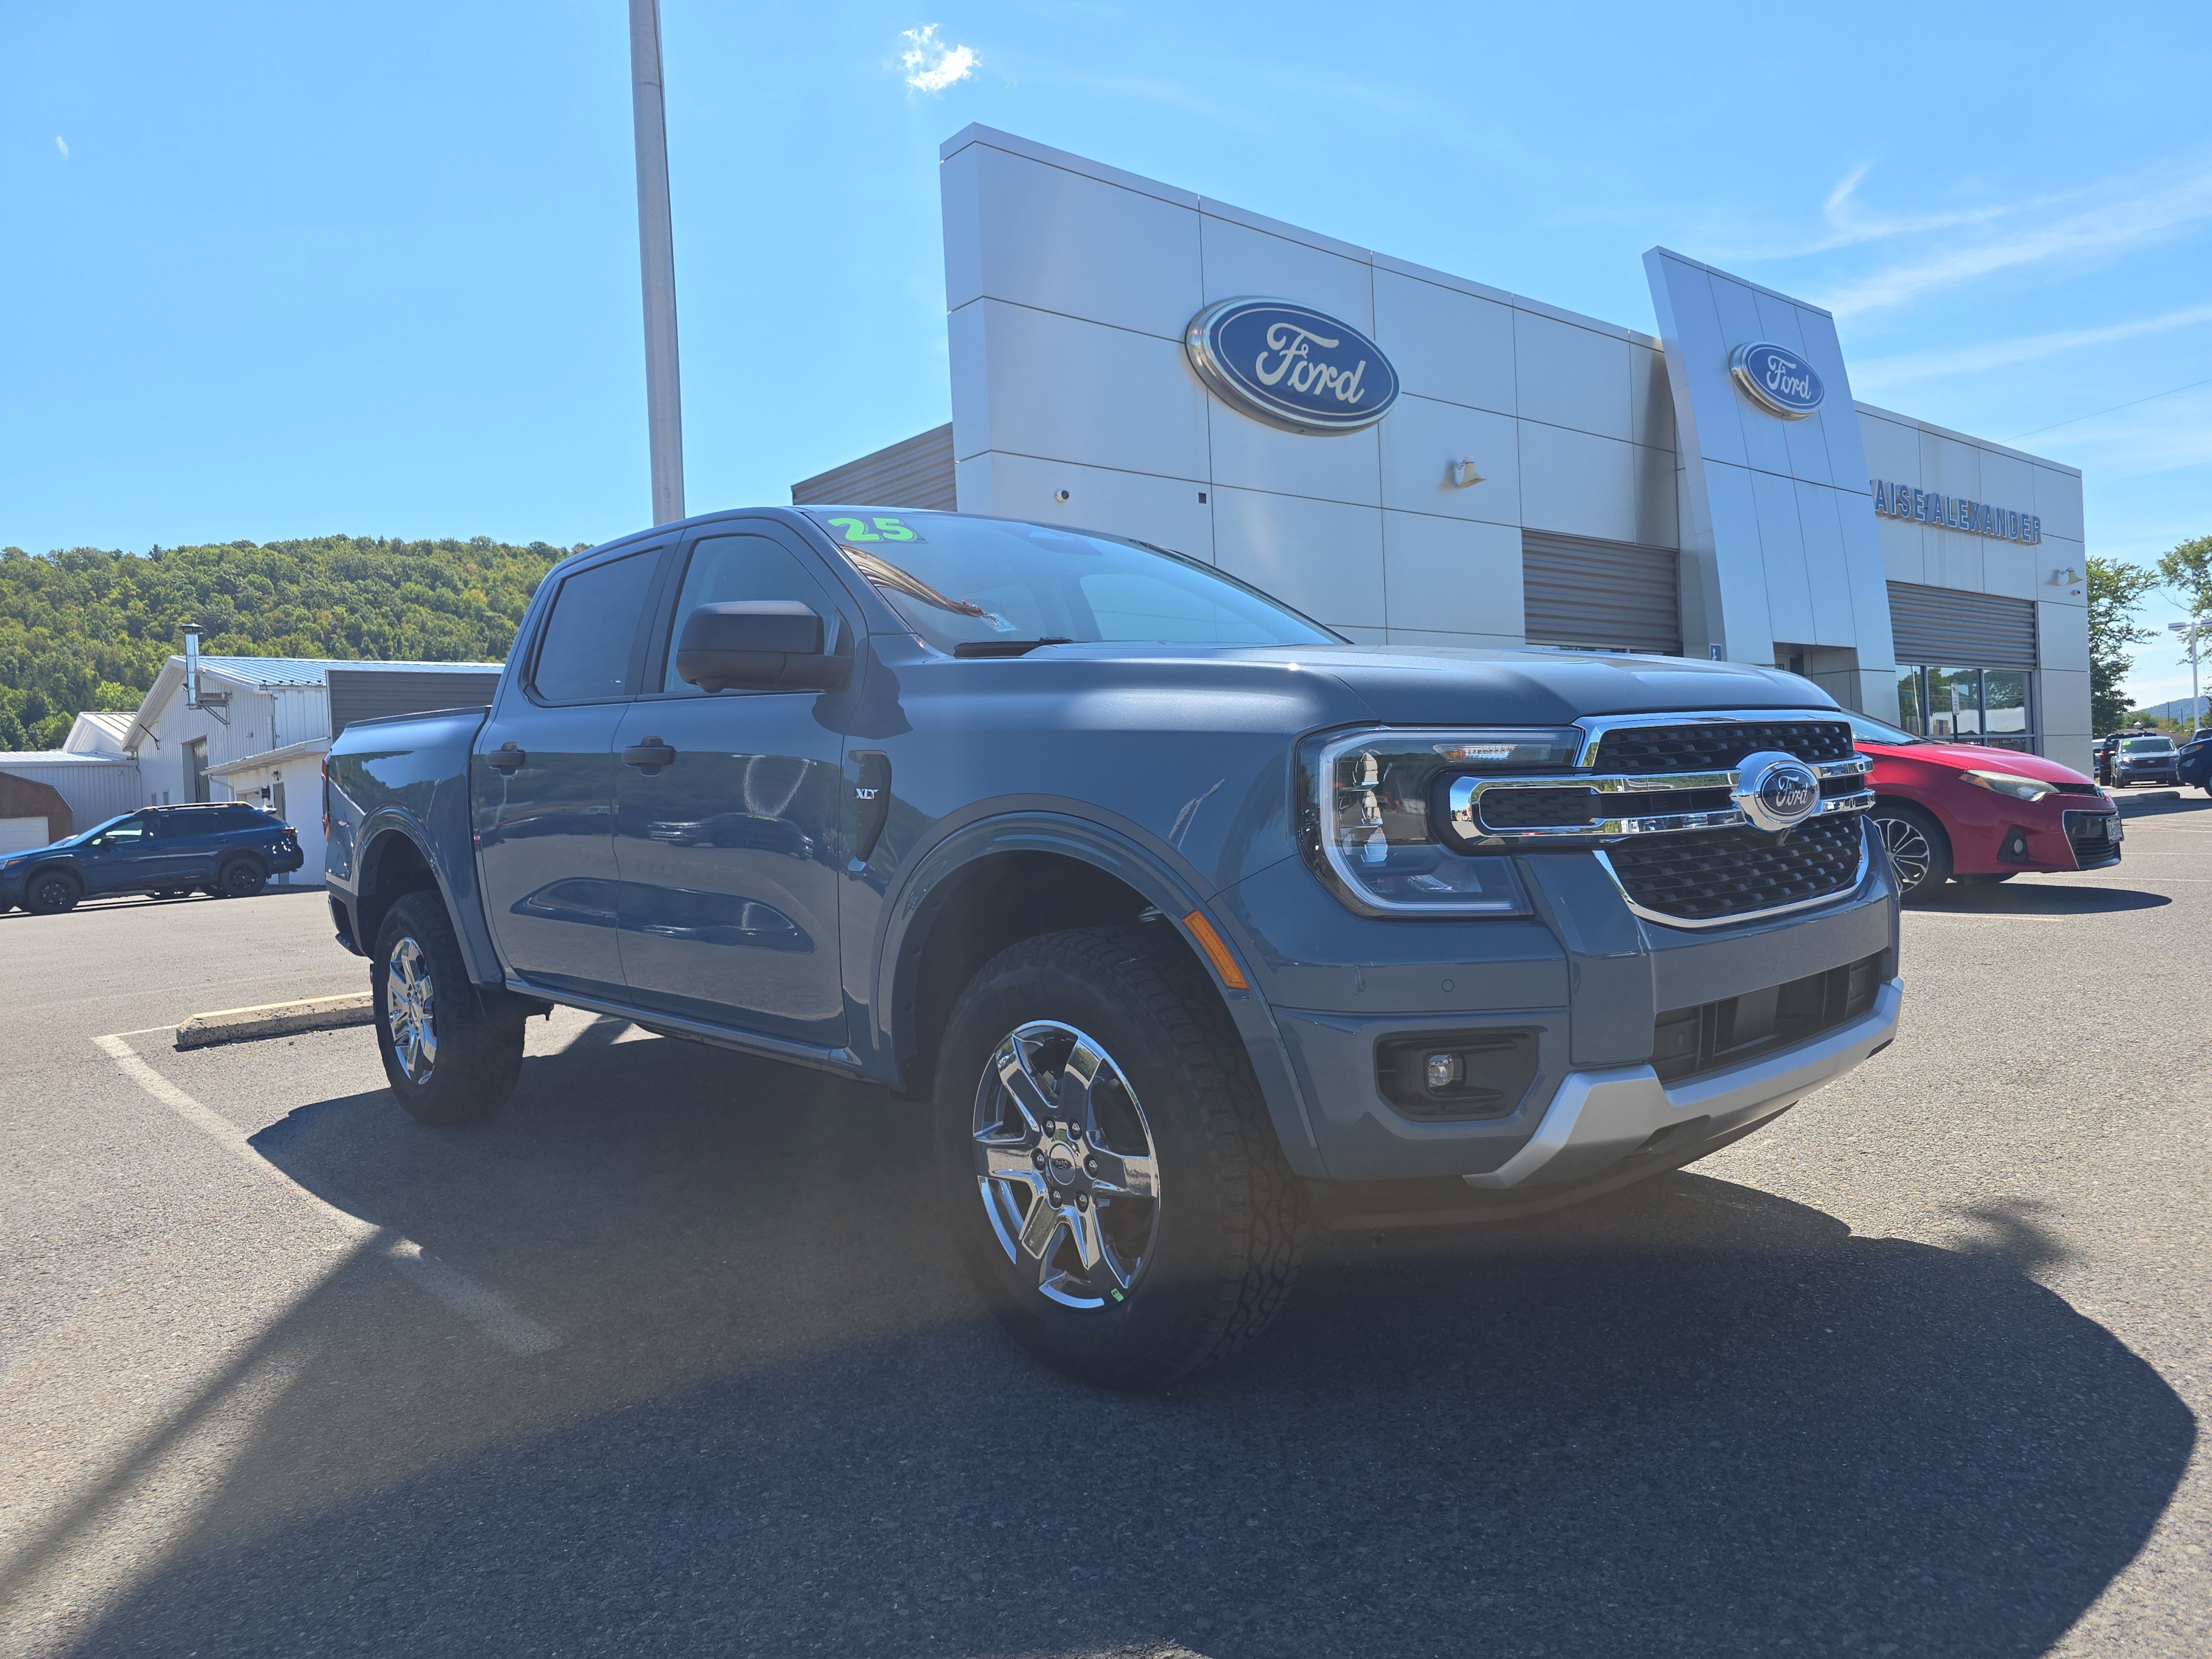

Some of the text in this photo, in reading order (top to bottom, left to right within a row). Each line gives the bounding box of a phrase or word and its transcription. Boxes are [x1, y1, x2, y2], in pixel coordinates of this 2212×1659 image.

[1255, 322, 1367, 404] Ford
[1766, 355, 1811, 400] Ford
[827, 517, 916, 542] 25
[1927, 492, 2042, 544] ALEXANDER
[854, 788, 879, 800] XLT
[1776, 774, 1809, 807] Ford
